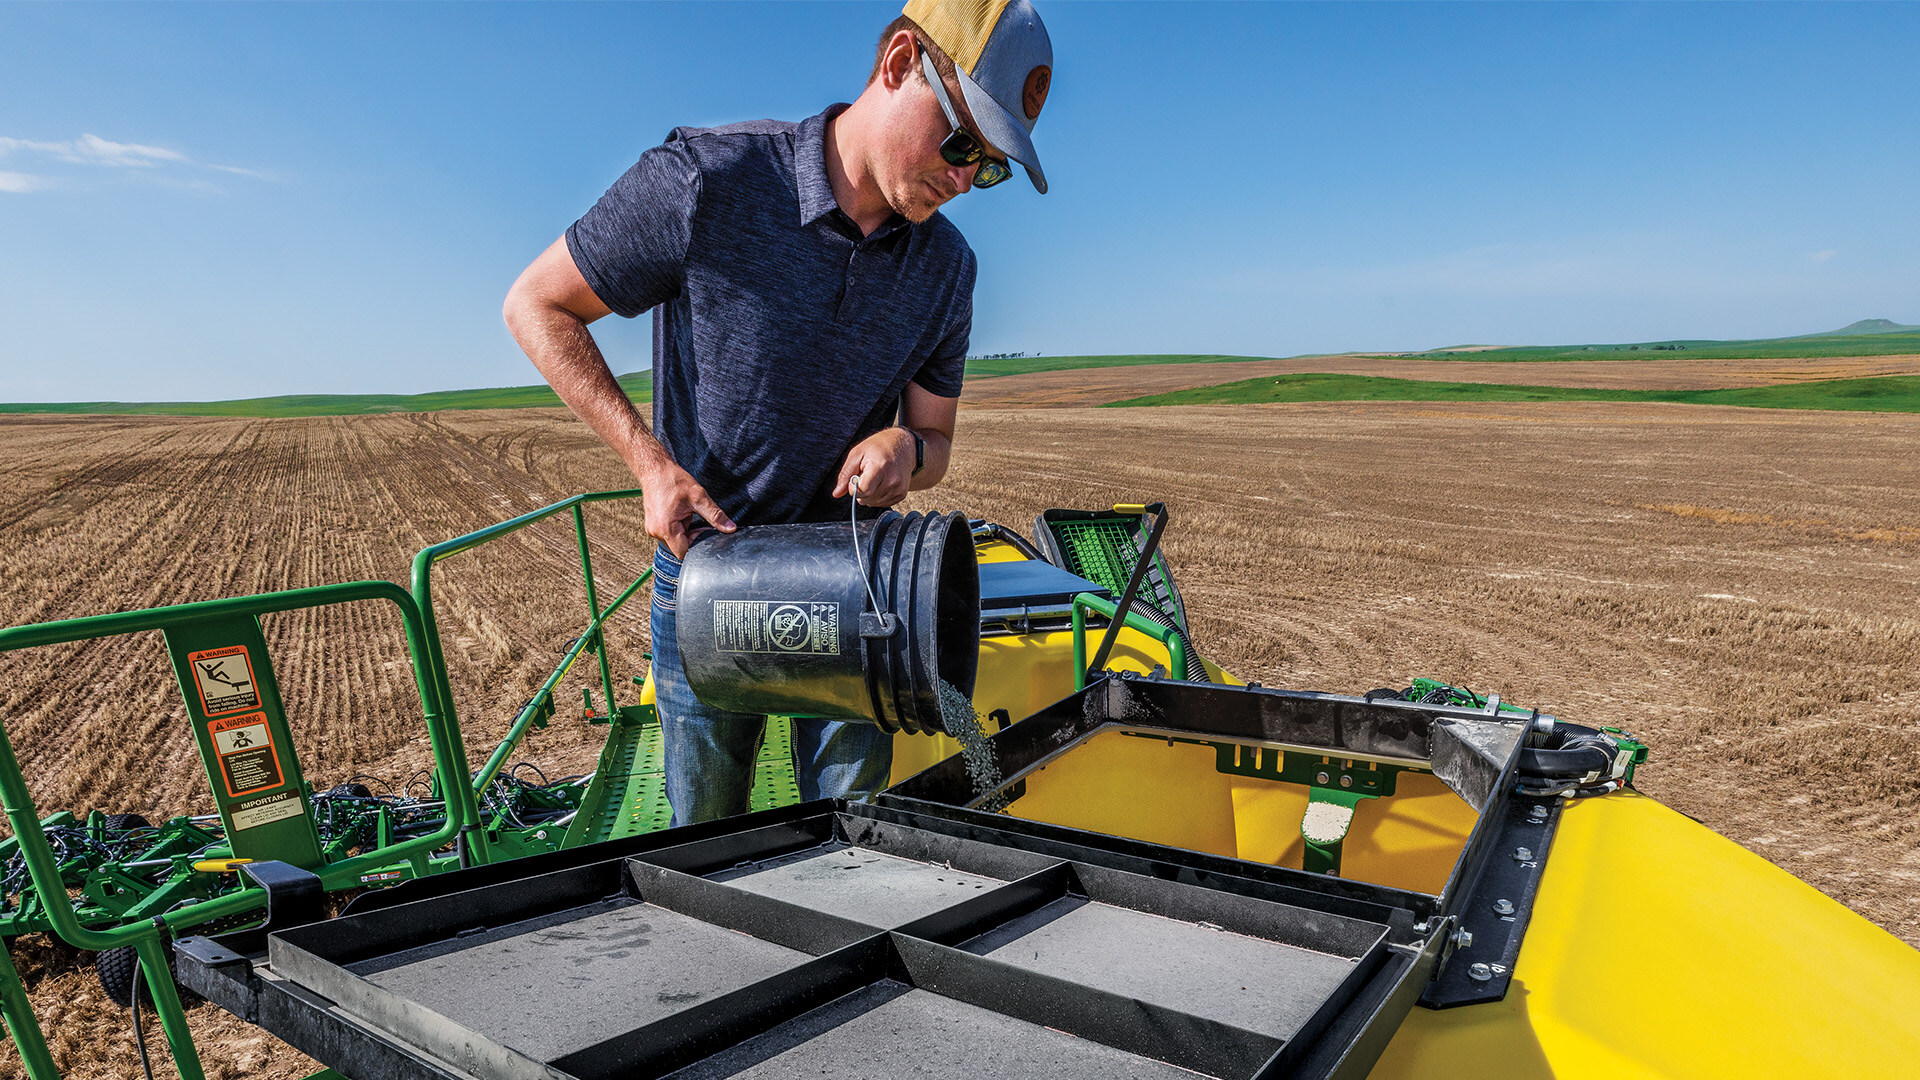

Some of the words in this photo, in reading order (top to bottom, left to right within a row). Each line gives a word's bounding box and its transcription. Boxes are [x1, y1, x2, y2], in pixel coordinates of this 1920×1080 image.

[820, 620, 829, 646] AVISO
[829, 613, 838, 653] WARNING
[205, 647, 240, 658] WARNING
[224, 714, 261, 728] WARNING
[241, 792, 288, 810] IMPORTANT
